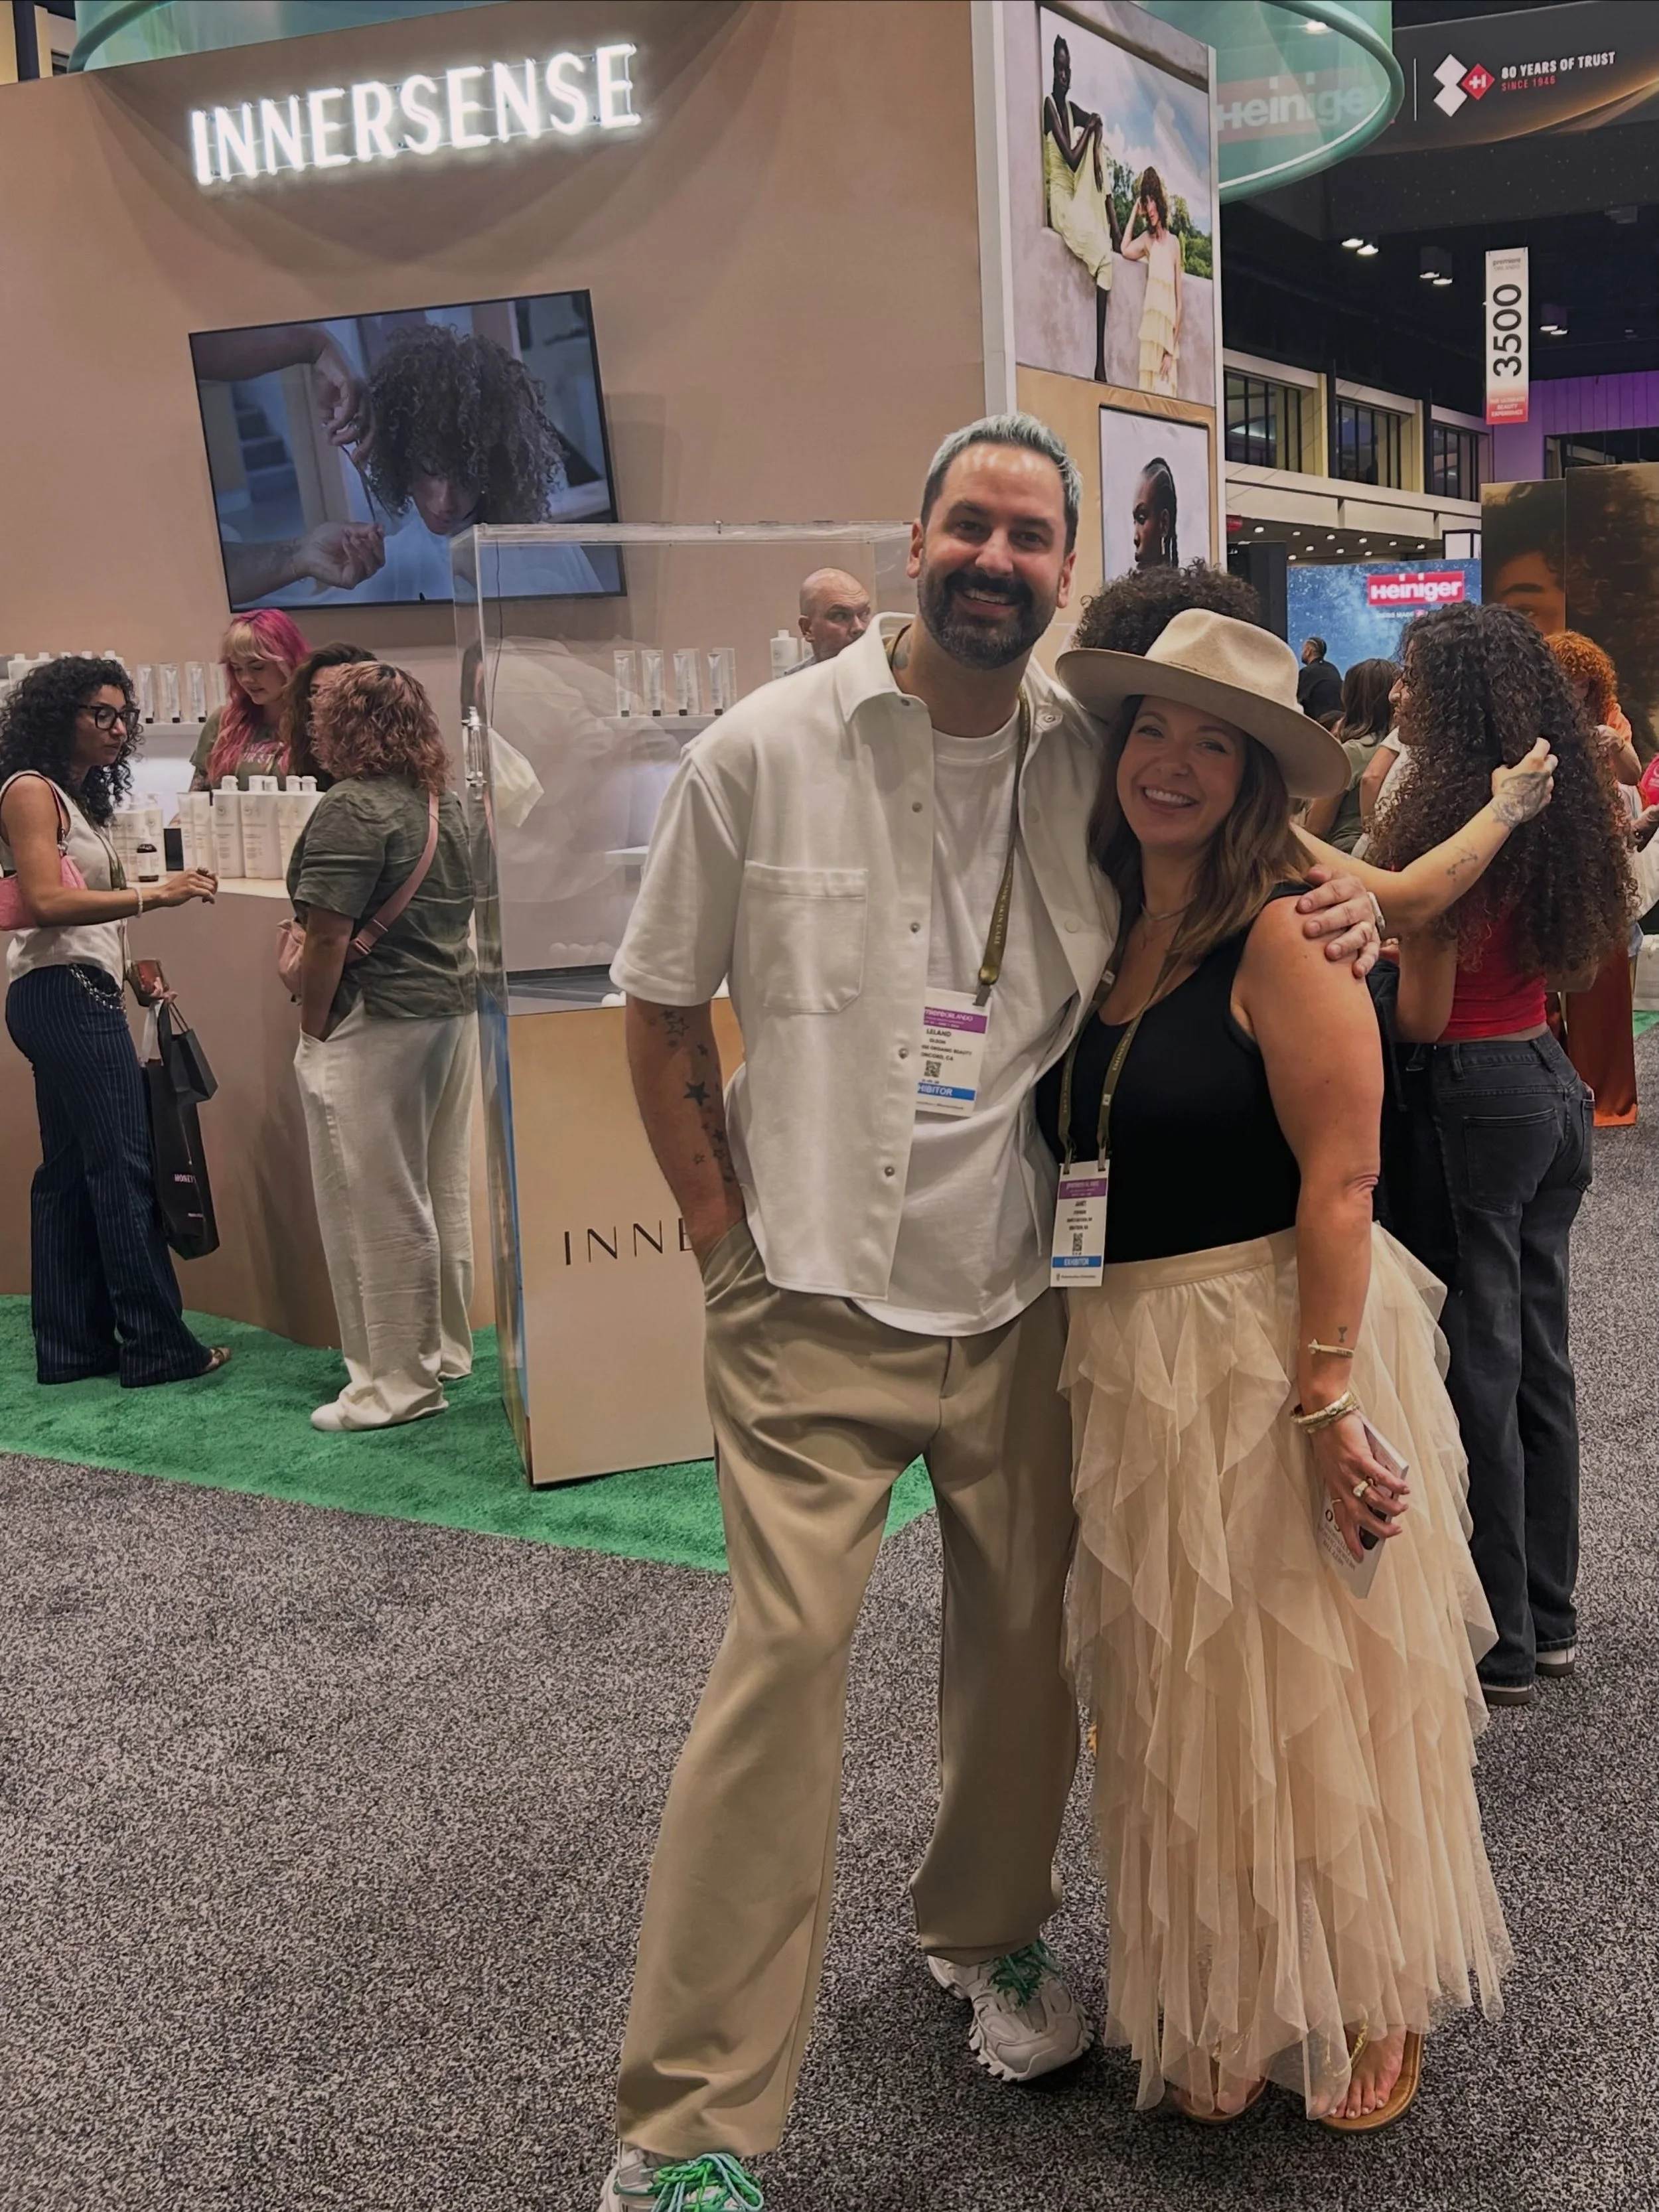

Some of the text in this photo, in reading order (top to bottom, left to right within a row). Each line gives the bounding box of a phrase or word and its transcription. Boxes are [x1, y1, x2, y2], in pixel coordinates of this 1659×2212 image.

[1501, 51, 1616, 80] 80 YEARS OF TRUST
[1501, 75, 1556, 92] SINCE 1946
[192, 42, 641, 185] INNERSENSE
[1492, 283, 1522, 377] 3500
[1370, 573, 1461, 601] Heiniger
[926, 1028, 952, 1037] LELAND
[565, 1217, 693, 1266] INNE
